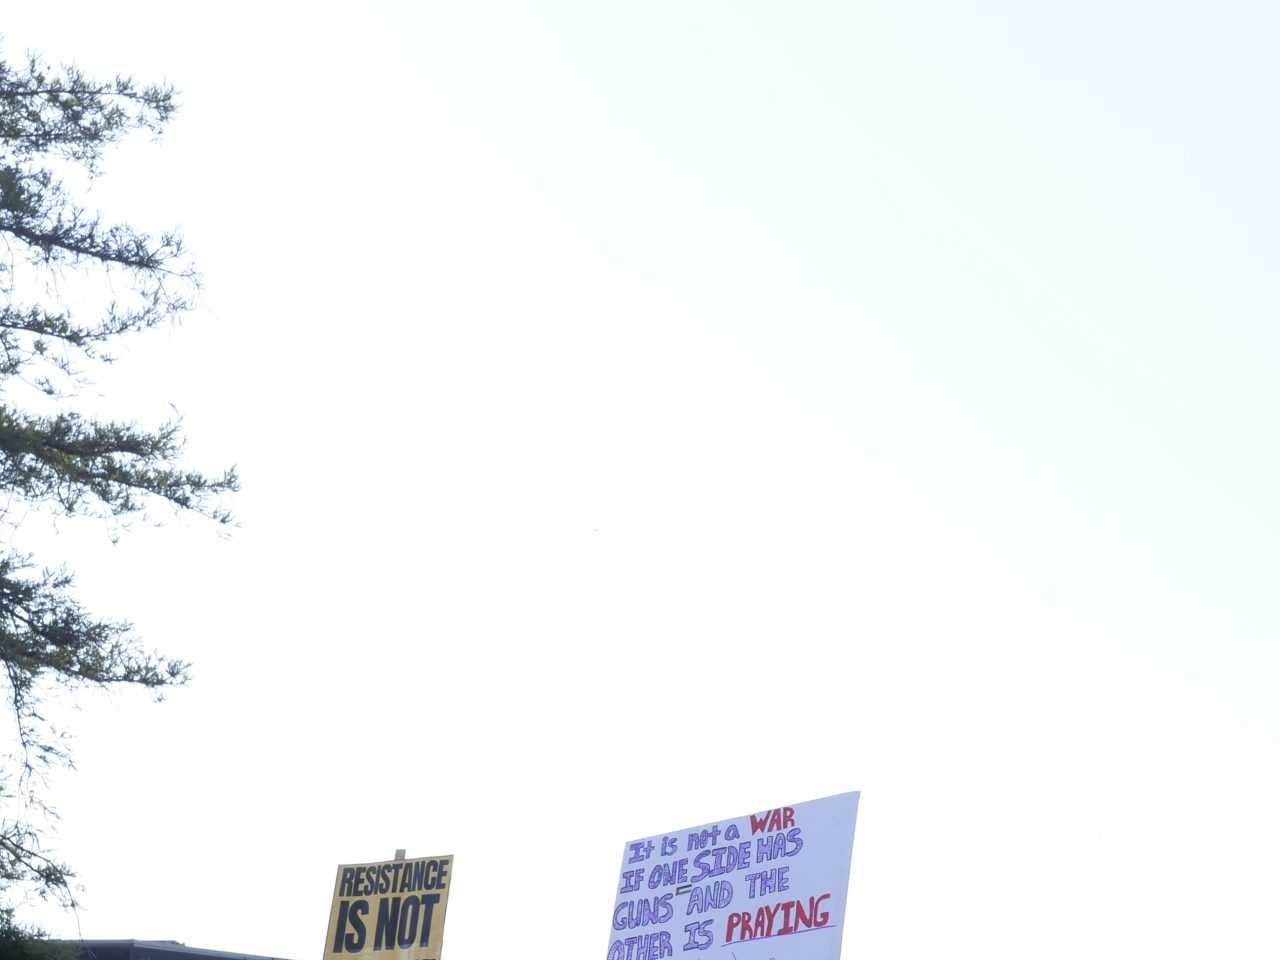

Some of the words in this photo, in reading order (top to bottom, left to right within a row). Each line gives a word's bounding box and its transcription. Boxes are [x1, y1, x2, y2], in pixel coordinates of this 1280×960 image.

[620, 868, 645, 894] IF
[648, 858, 688, 890] ONE
[691, 842, 751, 883] SIDE
[757, 828, 803, 864] HAS
[628, 841, 655, 864] It
[661, 836, 678, 857] is
[688, 825, 721, 850] not
[724, 824, 740, 841] a
[750, 807, 795, 835] WAR
[339, 859, 449, 897] RESISTANCE
[612, 892, 674, 931] GUNS
[686, 880, 734, 915] AND
[745, 866, 790, 899] THE
[332, 899, 370, 954] IS
[373, 893, 441, 951] NOT
[683, 919, 714, 951] IS
[725, 893, 831, 943] PRAYING
